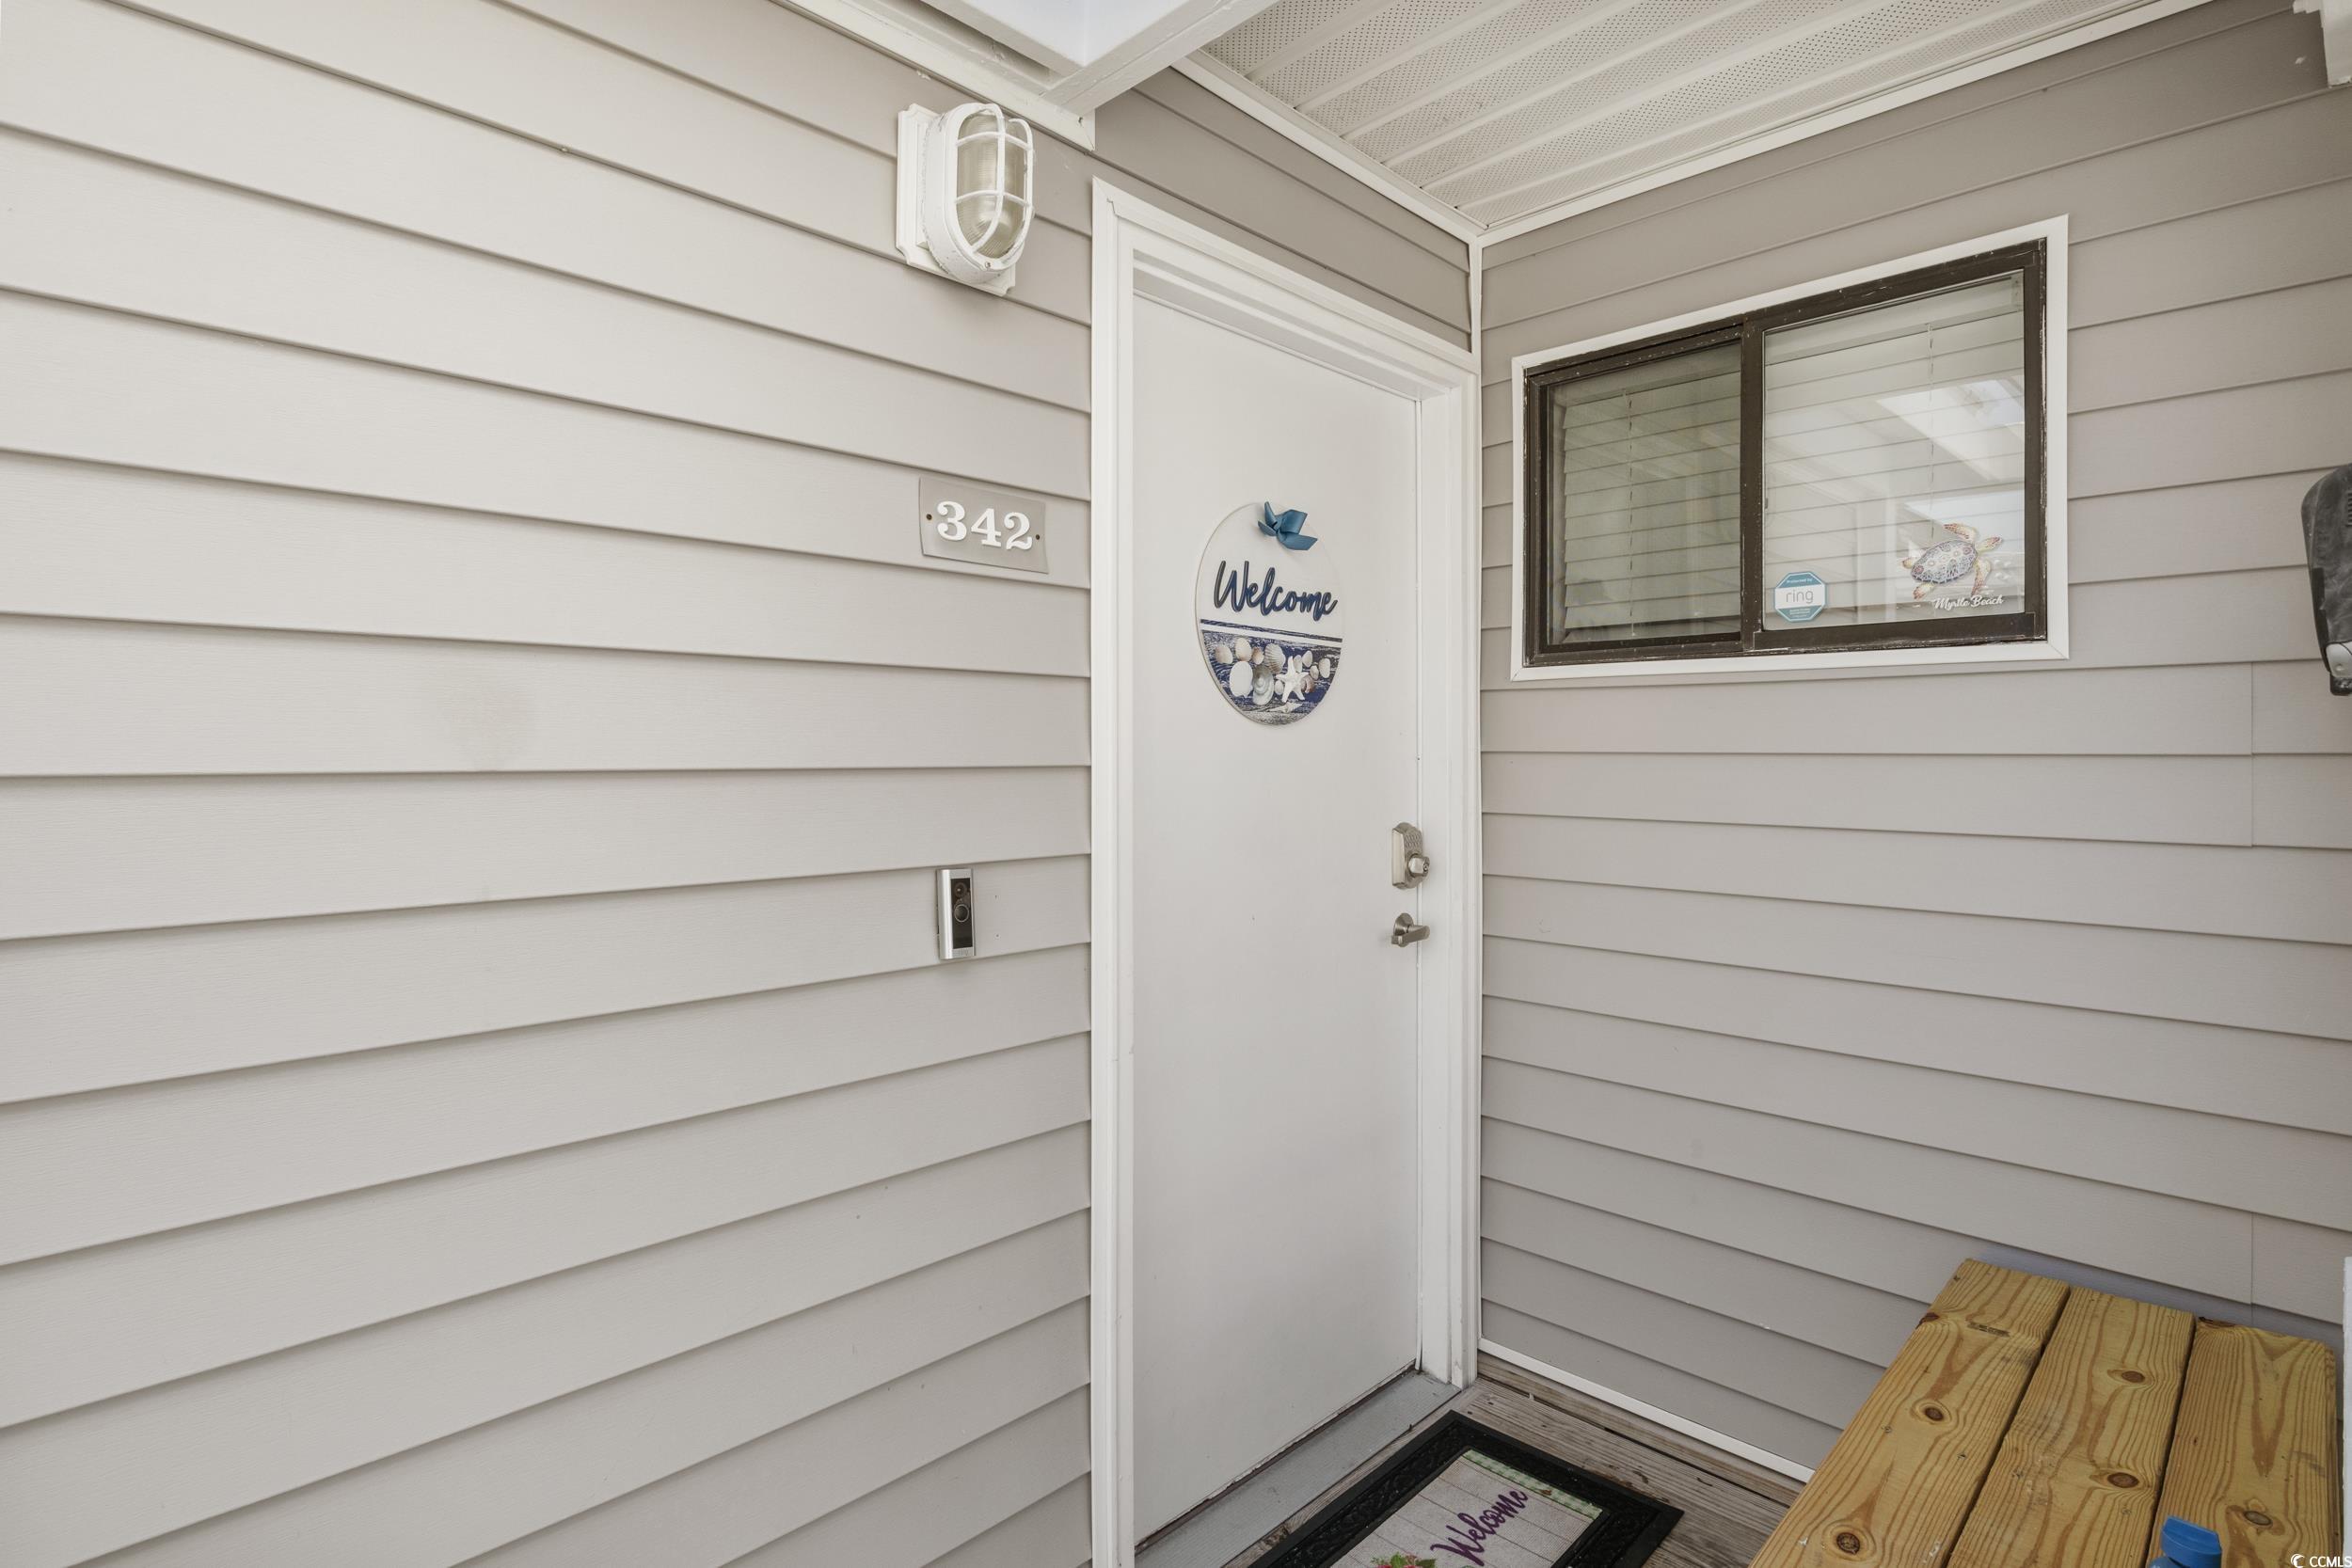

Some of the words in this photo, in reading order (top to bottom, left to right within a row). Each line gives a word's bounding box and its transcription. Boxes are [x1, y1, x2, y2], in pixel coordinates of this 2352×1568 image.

[937, 500, 1033, 550] 342
[1214, 560, 1339, 622] Welcome
[1786, 589, 1814, 604] ring
[1934, 597, 1971, 611] Myrtle
[1970, 594, 2004, 608] Beach
[1430, 1491, 1529, 1567] Welcome
